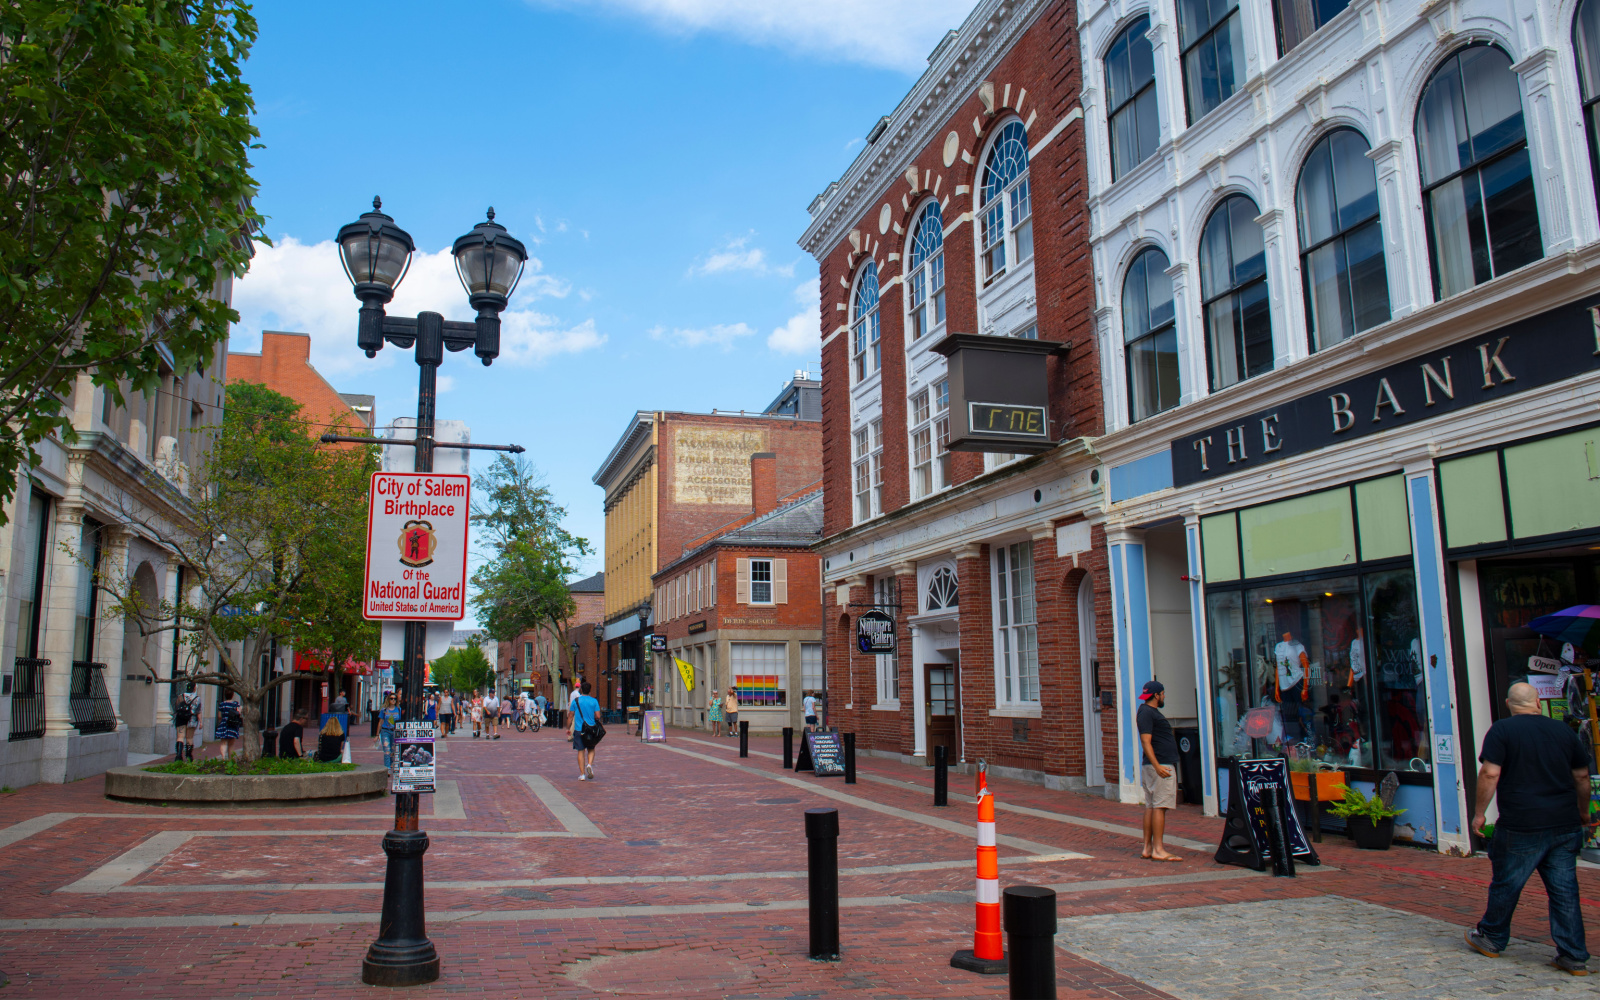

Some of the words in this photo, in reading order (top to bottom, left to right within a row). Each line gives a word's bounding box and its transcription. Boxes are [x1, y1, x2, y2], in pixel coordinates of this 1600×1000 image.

[1193, 413, 1283, 472] THE
[1328, 335, 1516, 435] BANK
[377, 477, 404, 499] City
[407, 478, 422, 496] of
[424, 478, 465, 497] Salem
[384, 499, 455, 519] Birthplace
[402, 569, 413, 581] Of
[416, 570, 430, 580] the
[370, 580, 420, 599] National
[423, 581, 461, 600] Guard
[369, 600, 394, 612] United
[395, 601, 418, 613] States
[419, 602, 428, 613] of
[428, 602, 459, 614] America
[871, 630, 894, 648] Gallery
[1533, 658, 1556, 670] Open
[406, 721, 433, 729] ENGLAND
[416, 729, 434, 738] RING
